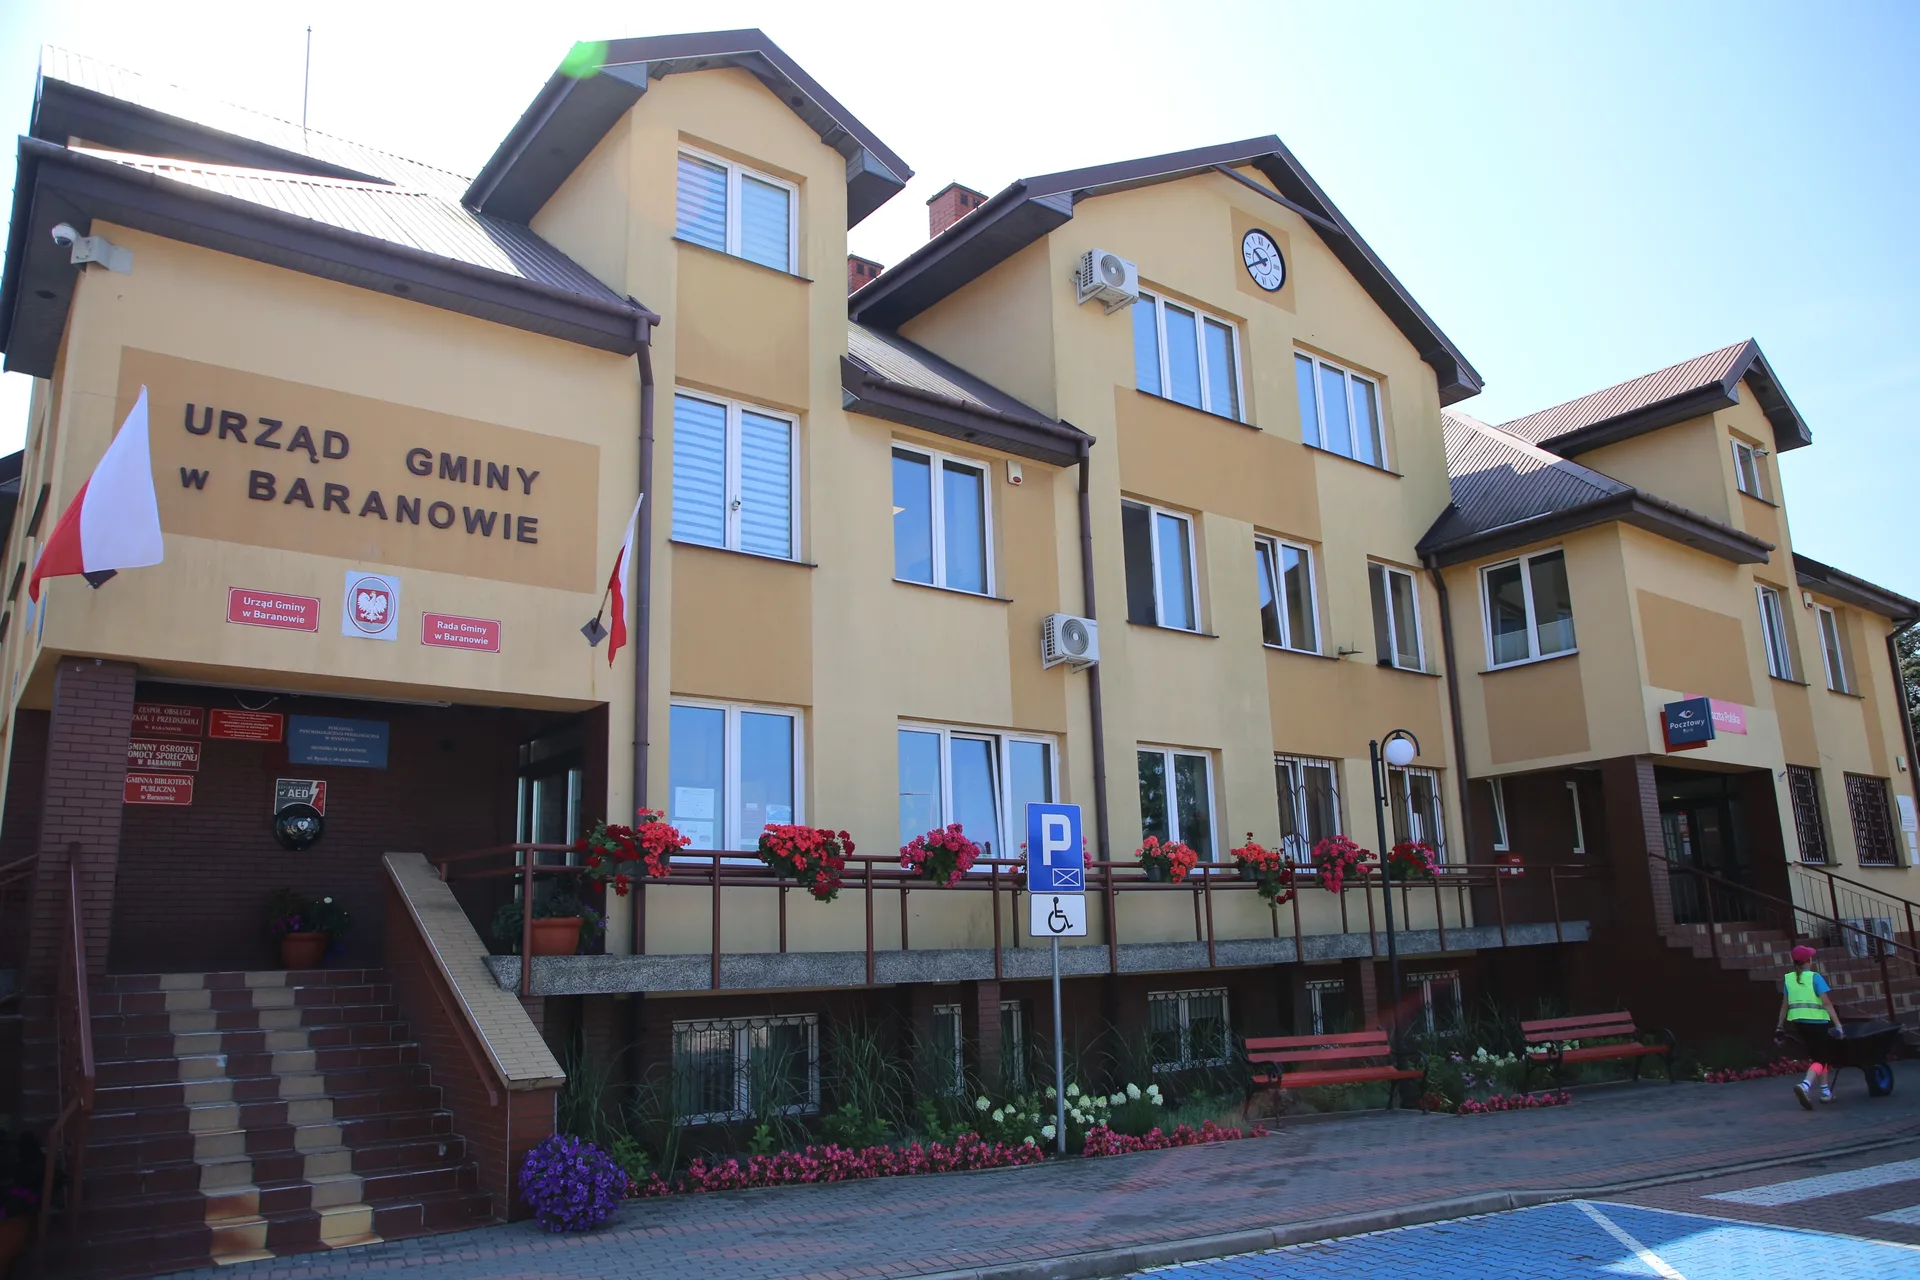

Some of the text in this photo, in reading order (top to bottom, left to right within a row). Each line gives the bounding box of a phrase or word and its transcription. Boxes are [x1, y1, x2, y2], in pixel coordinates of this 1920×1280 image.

[184, 403, 540, 495] URZĄD GMINY
[248, 469, 539, 544] BARANOWIE
[243, 596, 306, 613] Urząd Gminy
[242, 610, 305, 624] w Baranowie
[437, 620, 487, 635] Rada Gminy
[444, 632, 489, 645] Baranowie
[132, 713, 149, 721] ZKÓŁ
[1669, 719, 1705, 729] Pocztowy
[160, 743, 194, 753] OŚRODEK
[127, 750, 198, 761] OMOCY SPOŁECZNEJ
[147, 759, 182, 767] BARANOWIE
[126, 776, 192, 786] GMINNA BIBLIOTEKA
[140, 785, 176, 793] PUBLICZNA
[287, 788, 309, 798] AED
[147, 793, 175, 801] Baranowie
[1041, 813, 1072, 866] P
